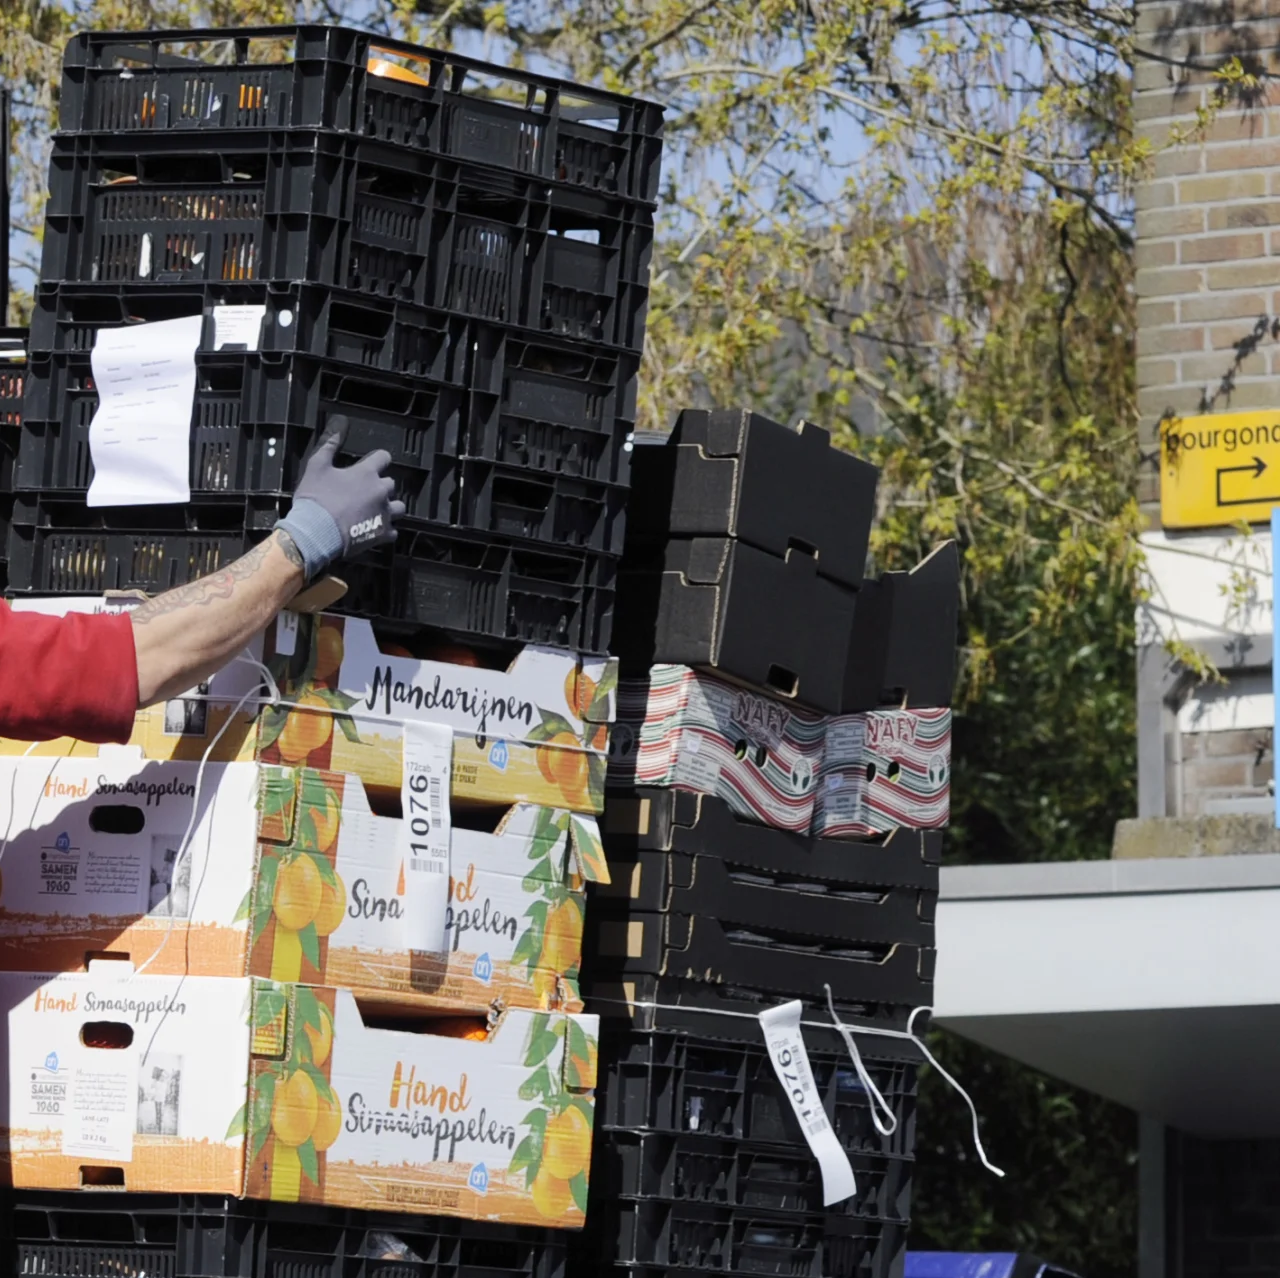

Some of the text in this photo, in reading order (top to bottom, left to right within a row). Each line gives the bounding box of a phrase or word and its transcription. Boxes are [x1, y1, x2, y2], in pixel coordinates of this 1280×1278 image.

[366, 665, 533, 750] Mandarijnen
[45, 774, 196, 807] Hand Sinaasappelen
[409, 774, 430, 857] 1076
[41, 864, 78, 876] SAMEN
[46, 881, 71, 893] 1960
[33, 988, 187, 1023] Hand Sinaasappelen
[31, 1084, 67, 1095] SAMEN
[389, 1061, 472, 1114] Hand
[36, 1101, 60, 1113] 1960
[345, 1092, 516, 1163] Sinaasappelen
